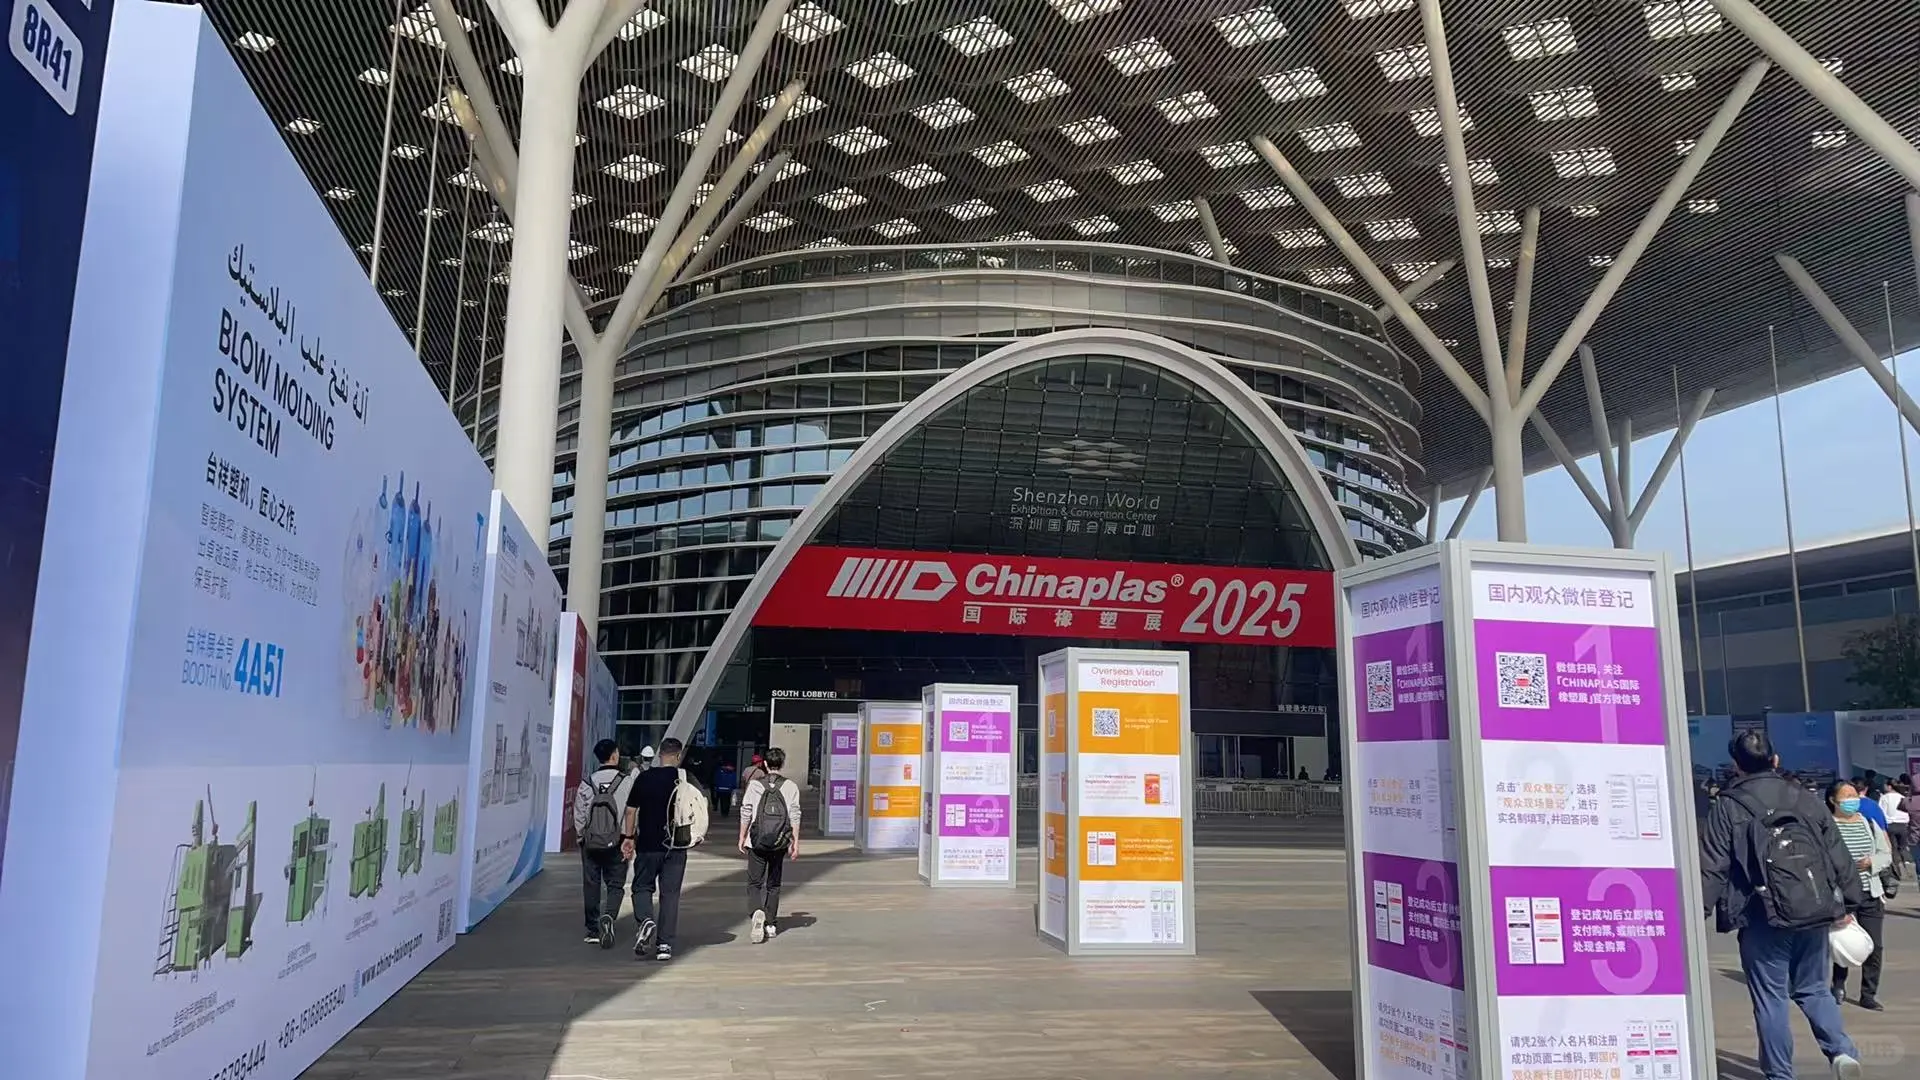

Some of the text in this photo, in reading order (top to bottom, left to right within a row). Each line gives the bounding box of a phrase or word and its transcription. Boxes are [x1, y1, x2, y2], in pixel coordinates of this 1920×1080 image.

[23, 4, 72, 92] 8R41
[219, 307, 335, 451] BLOW MOLDING
[213, 369, 281, 458] SYSTEM
[1012, 486, 1161, 511] Shenzhen World
[1010, 504, 1157, 521] Exhibition & Convention Center
[1009, 516, 1156, 537] 深圳国际会展中心
[1361, 586, 1440, 618] 国内观众微信登记
[1488, 583, 1635, 608] 国内观众微信登记
[962, 606, 1162, 632] 国际橡塑展
[1180, 579, 1308, 638] 2025
[182, 659, 218, 690] BOOTH
[234, 638, 285, 698] 4A51
[1091, 667, 1164, 677] Overseas Visitor
[802, 691, 837, 699] LOBBY(E)
[1100, 678, 1156, 688] Registration
[1570, 908, 1665, 922] 登记成功后立即微信
[1573, 940, 1627, 953] 处现金购票
[1511, 1035, 1618, 1048] 请凭2张个人名片和注册
